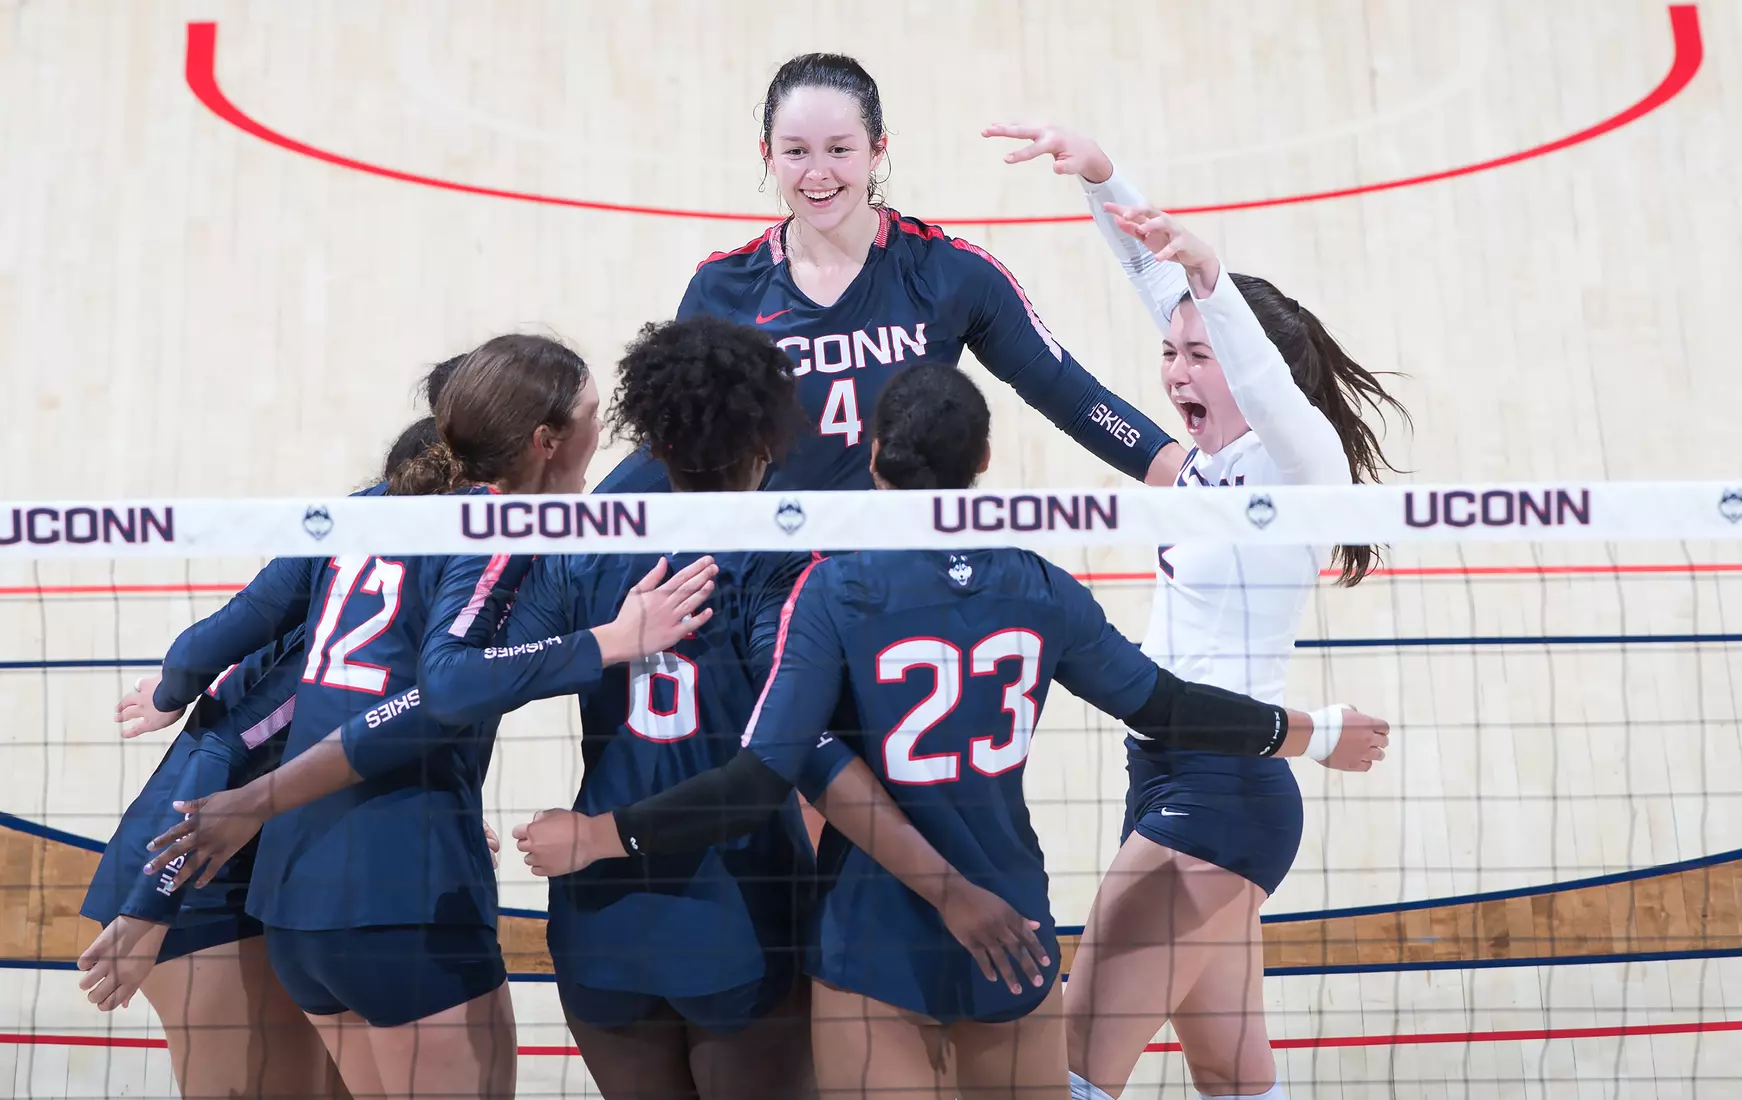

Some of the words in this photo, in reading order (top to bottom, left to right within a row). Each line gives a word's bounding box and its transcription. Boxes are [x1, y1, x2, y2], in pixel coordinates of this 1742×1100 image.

[776, 323, 927, 377] CONN
[820, 377, 863, 448] 4
[1088, 402, 1141, 448] SKIES
[0, 506, 174, 545] UCONN
[461, 500, 647, 540] UCONN
[932, 494, 1118, 533] UCONN
[1404, 488, 1590, 528] UCONN
[302, 554, 406, 696] 12
[364, 688, 421, 729] SKIES
[875, 627, 1044, 786] 23
